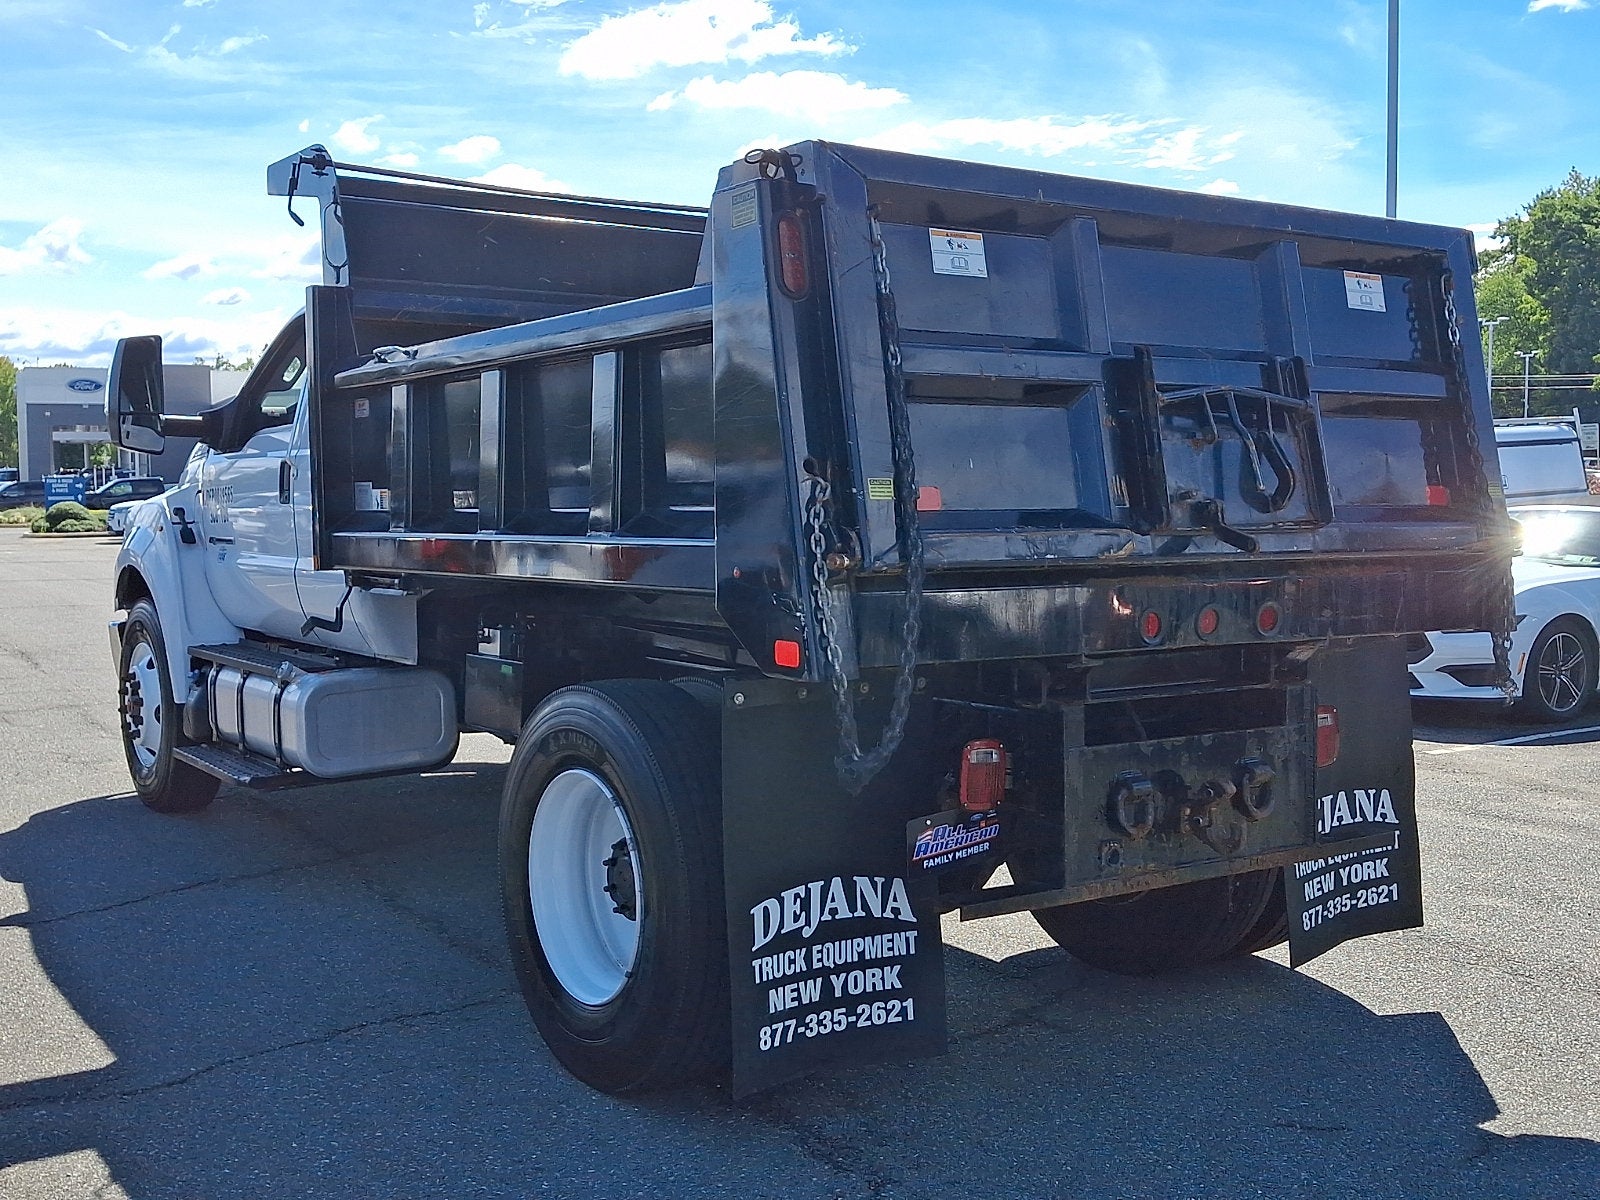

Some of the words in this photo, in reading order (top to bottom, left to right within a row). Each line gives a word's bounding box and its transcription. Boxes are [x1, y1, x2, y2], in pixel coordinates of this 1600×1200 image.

[733, 189, 755, 204] CAUTION
[74, 380, 96, 390] Ford
[932, 823, 966, 842] ALL
[1317, 788, 1400, 834] JANA
[913, 824, 1000, 859] AMERICAN
[923, 852, 954, 869] FAMILY
[955, 842, 990, 860] MEMBER
[1303, 870, 1335, 902] NEW
[1338, 857, 1390, 887] YORK
[750, 875, 918, 953] DEJANA
[1302, 882, 1399, 932] 877-335-2621
[752, 948, 807, 985] TRUCK
[812, 930, 918, 970] EQUIPMENT
[768, 977, 822, 1014] NEW
[830, 965, 903, 999] YORK
[759, 998, 915, 1051] 877-335-2621
